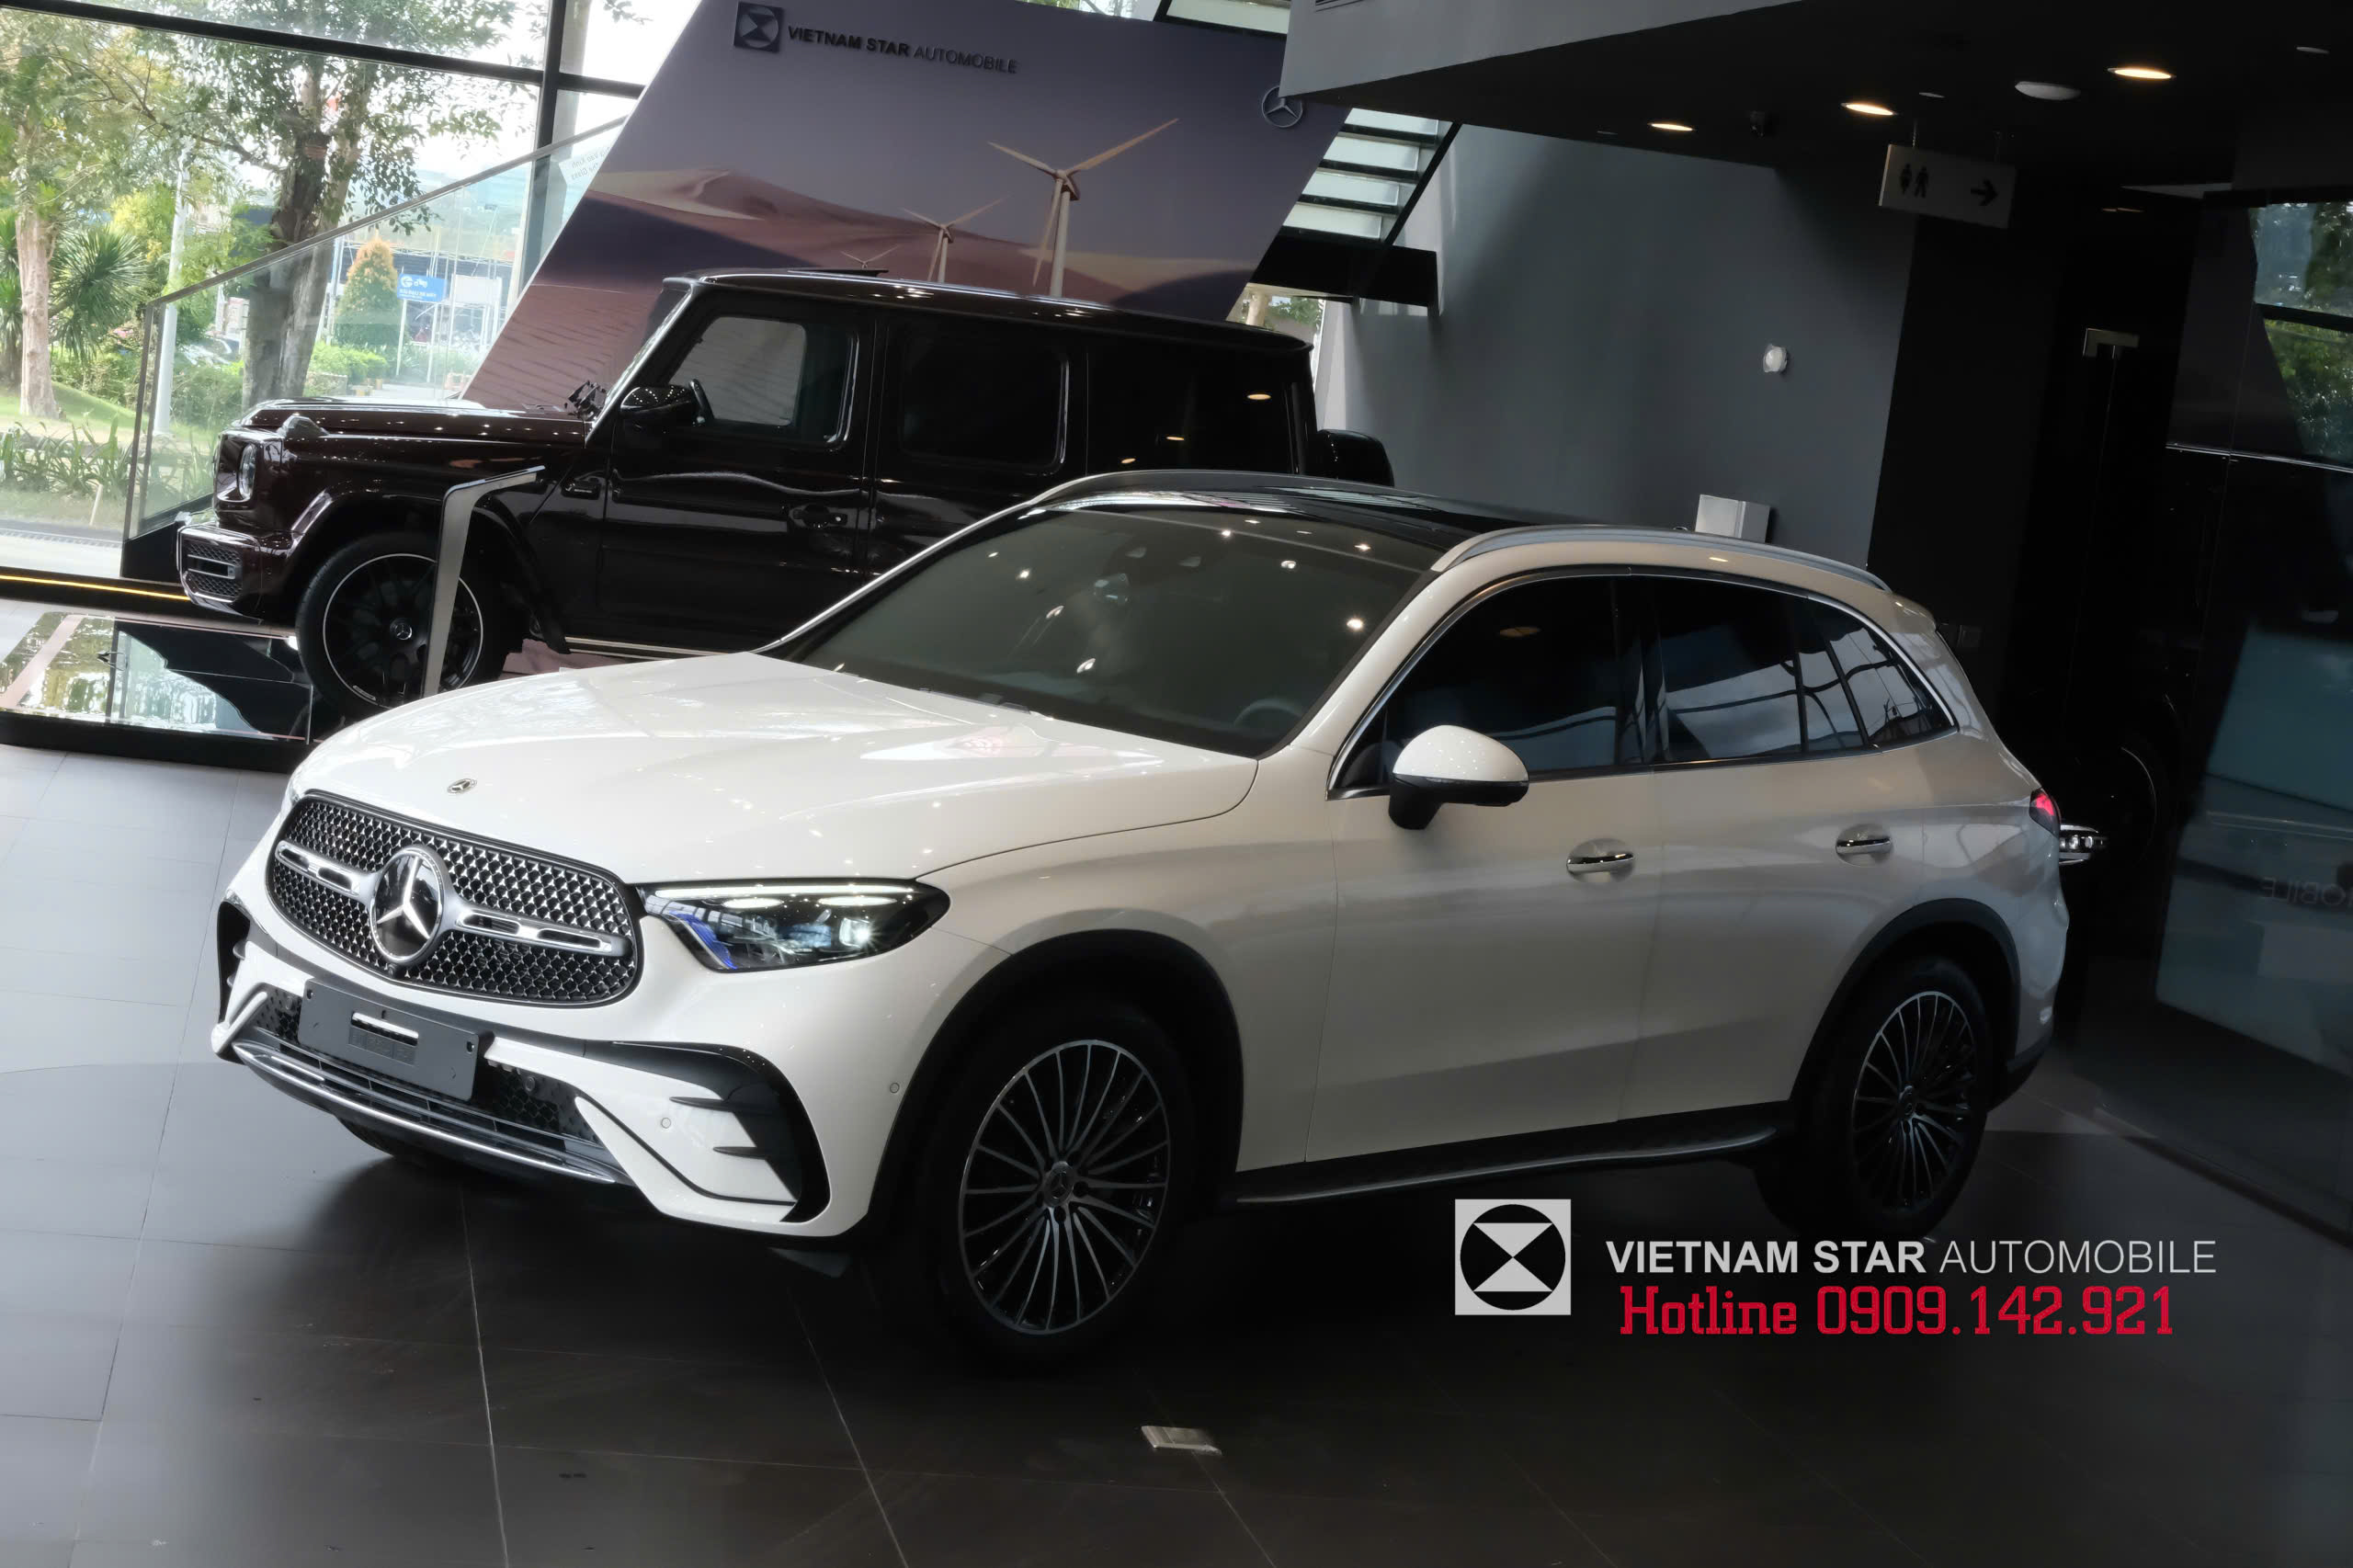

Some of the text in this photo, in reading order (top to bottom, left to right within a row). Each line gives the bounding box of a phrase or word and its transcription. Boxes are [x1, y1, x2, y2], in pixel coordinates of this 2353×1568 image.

[788, 26, 1017, 74] VIETNAM STAR AUTOMOBILE
